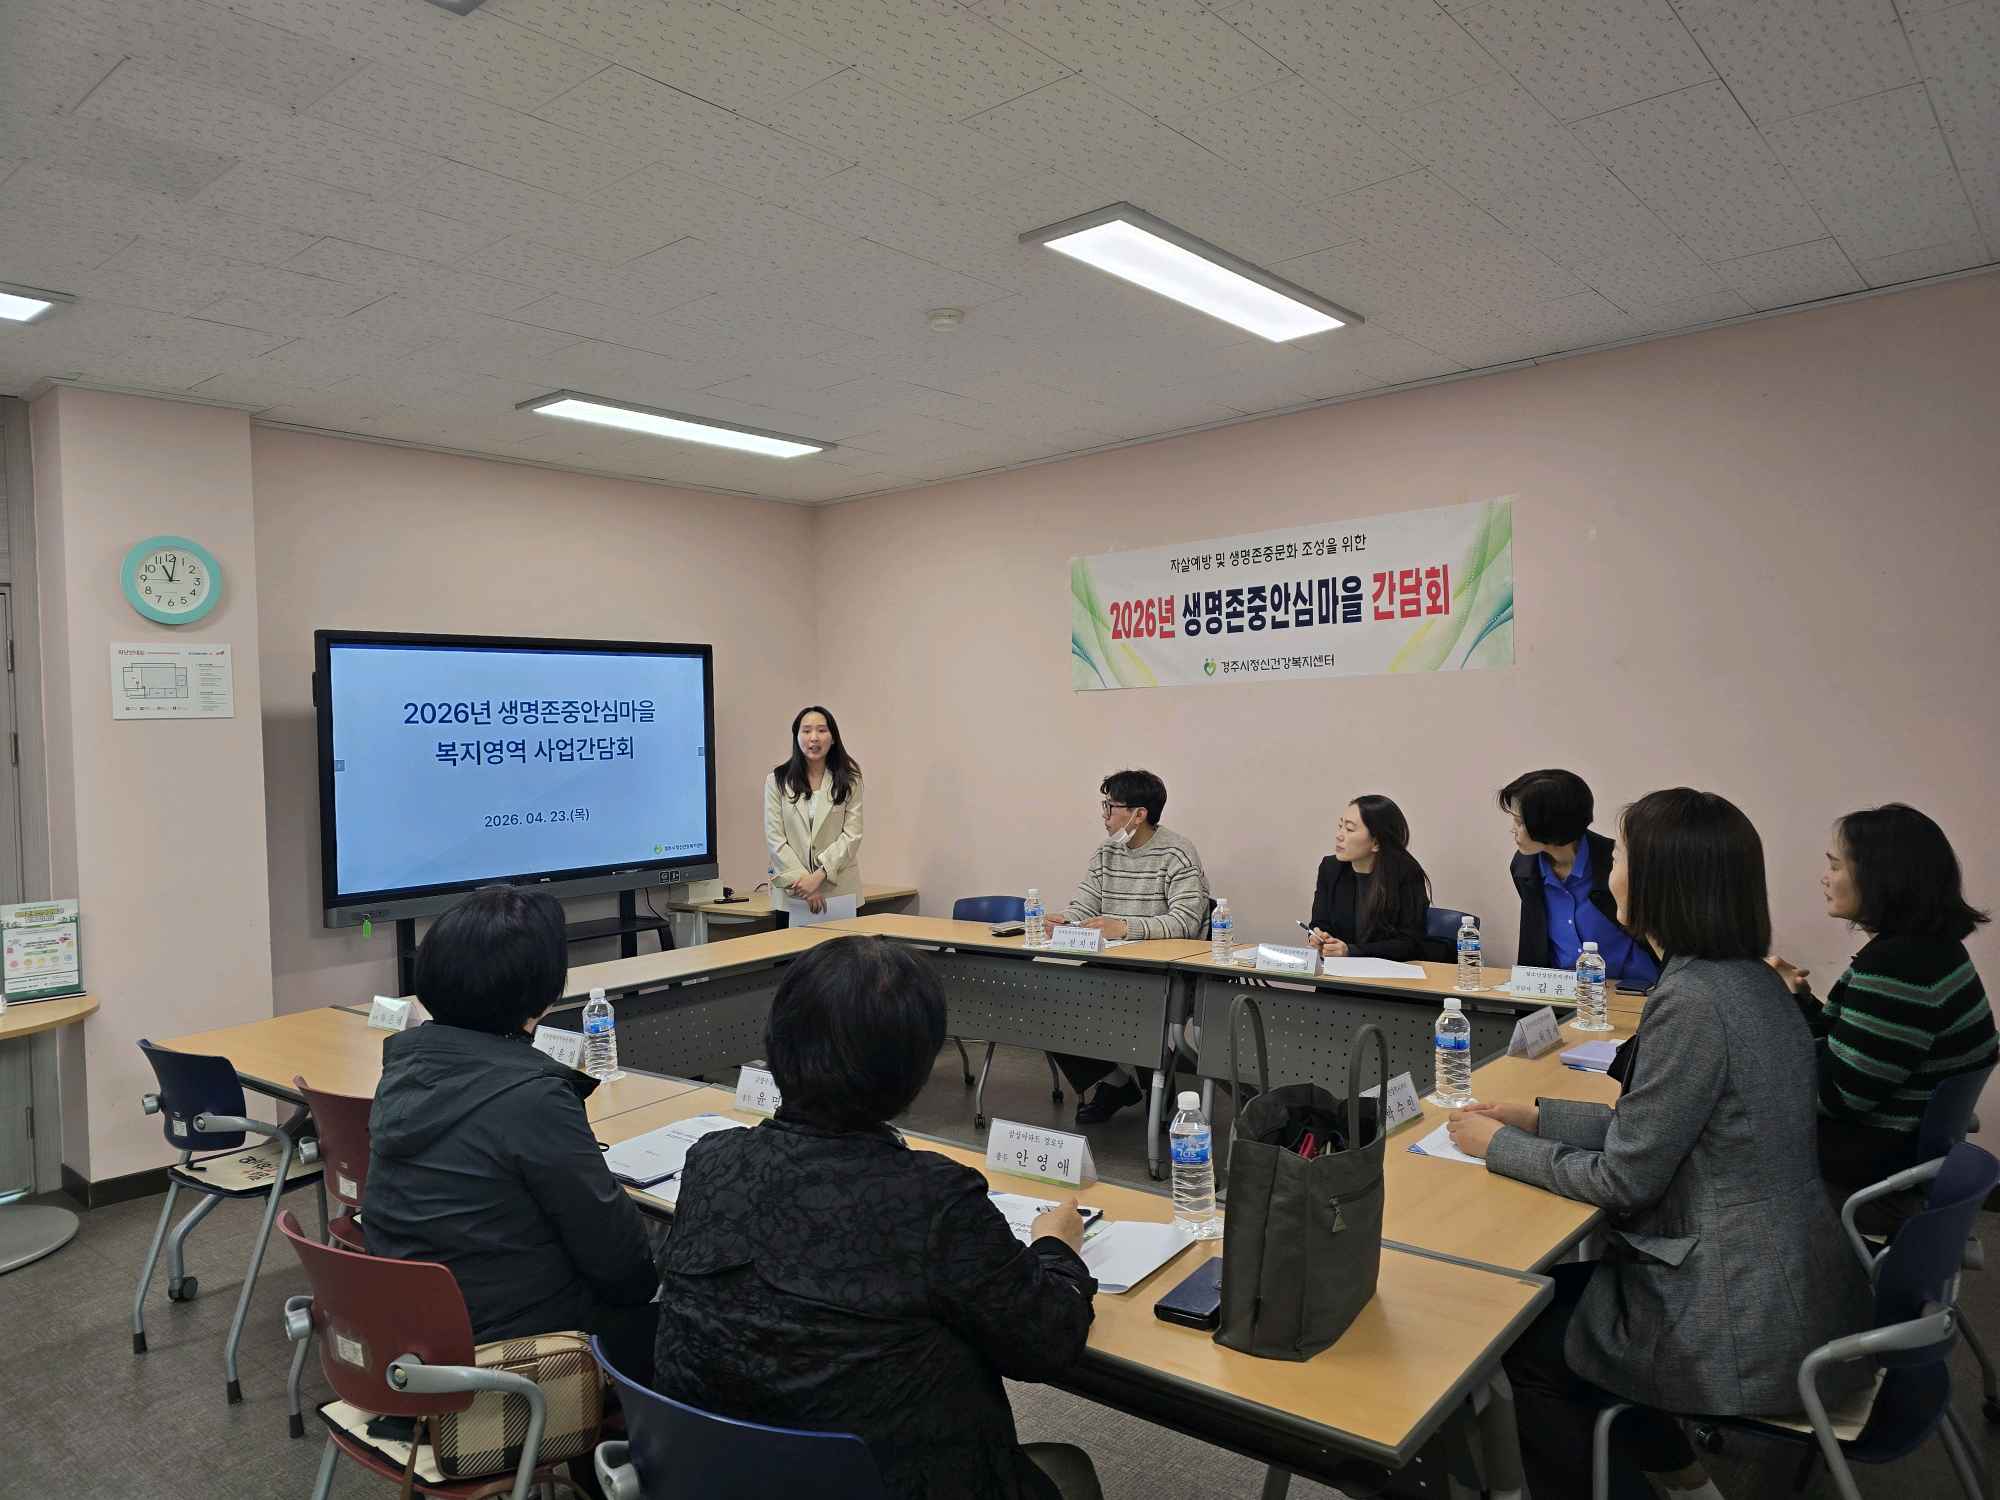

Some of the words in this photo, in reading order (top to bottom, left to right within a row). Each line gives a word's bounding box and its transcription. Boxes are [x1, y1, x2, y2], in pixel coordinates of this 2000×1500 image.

[166, 553, 176, 562] 12
[1170, 556, 1212, 573] 자살예방
[1216, 552, 1225, 568] 및
[1229, 543, 1298, 567] 생명존중문화
[1302, 537, 1338, 556] 조성을
[1342, 534, 1367, 552] 위한
[145, 564, 156, 573] 10
[188, 565, 196, 574] 2
[193, 577, 201, 586] 3
[145, 586, 152, 595] 8
[190, 589, 196, 597] 4
[155, 595, 162, 604] 7
[168, 599, 174, 607] 6
[181, 596, 188, 605] 5
[1110, 594, 1176, 640] 2026년
[1182, 575, 1364, 637] 생명존중안심마을
[1372, 564, 1450, 621] 간담회
[1220, 654, 1335, 674] 경주시정신건강복지센터
[404, 700, 492, 725] 2026년
[498, 699, 656, 725] 생명존중안심마을
[435, 739, 527, 767] 복지영역
[534, 736, 635, 763] 사업간담회
[484, 814, 523, 828] 2026.
[526, 812, 547, 824] 04.
[550, 808, 591, 823] 23.(목)
